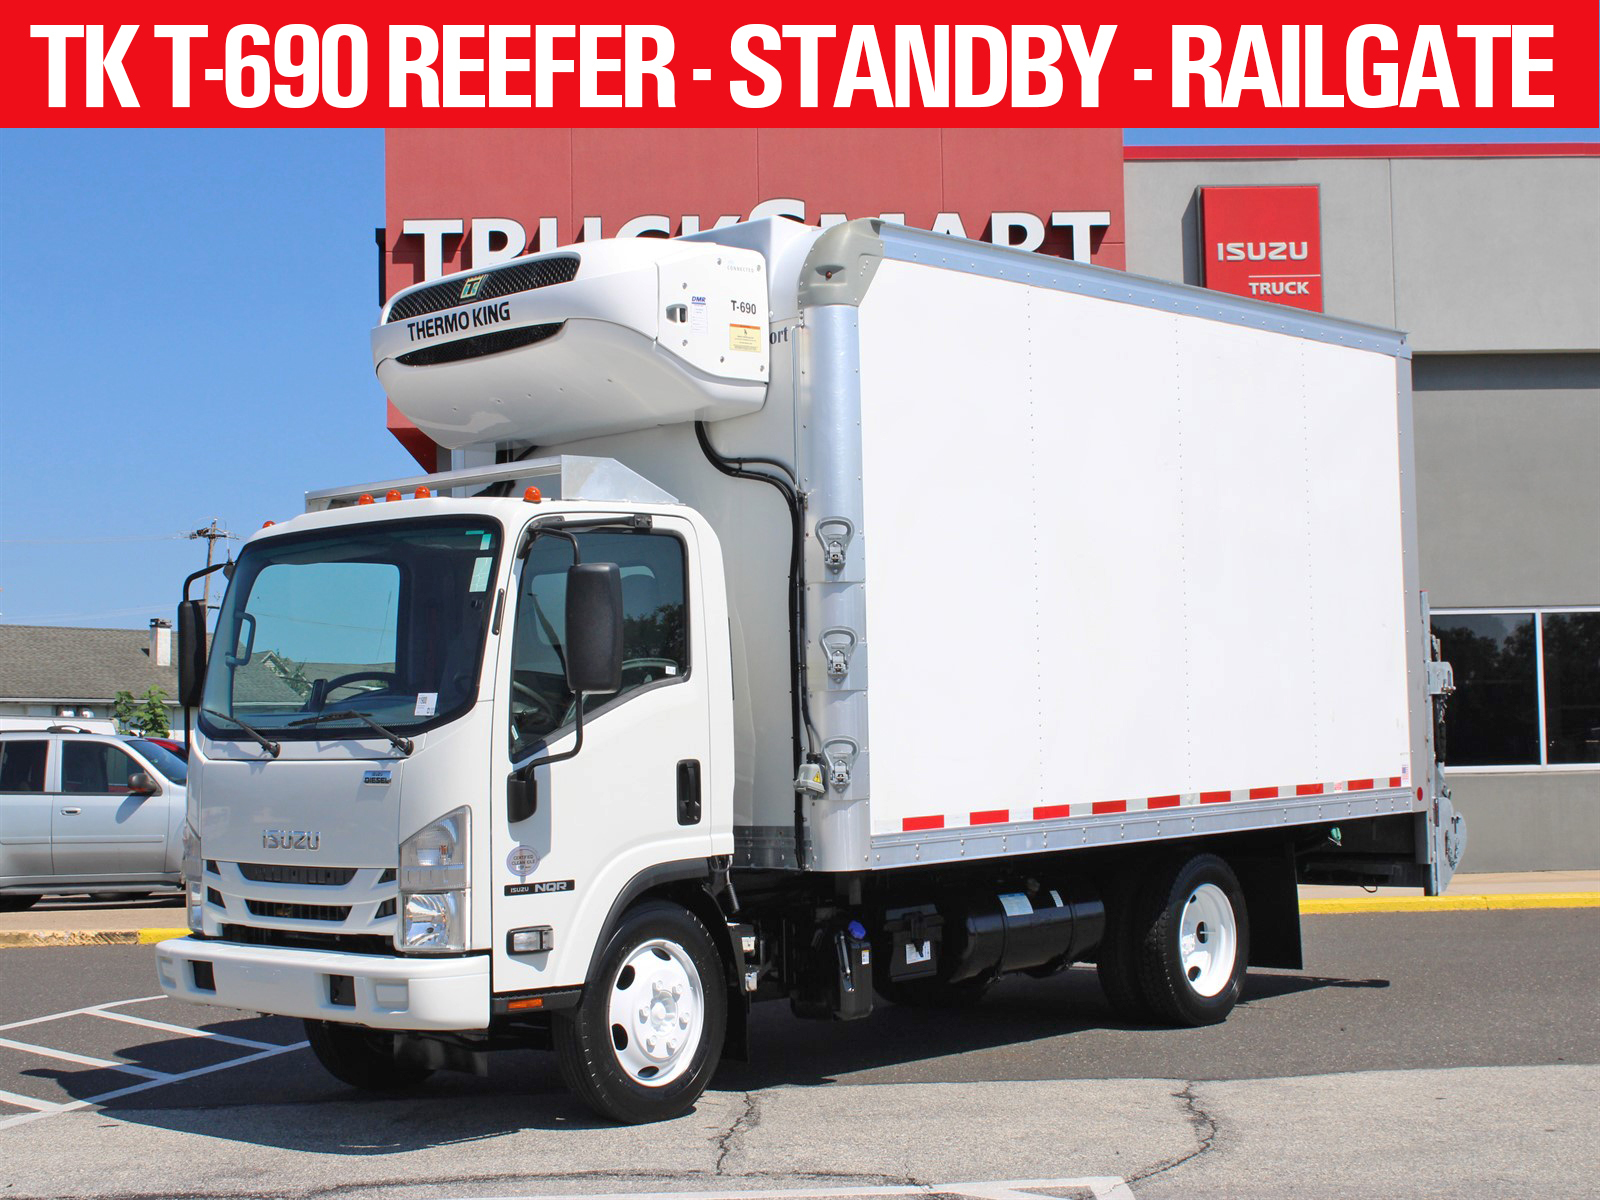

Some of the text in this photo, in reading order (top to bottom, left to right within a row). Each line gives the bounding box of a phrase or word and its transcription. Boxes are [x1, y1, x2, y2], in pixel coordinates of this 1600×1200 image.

[1217, 241, 1308, 261] ISUZU
[1248, 282, 1309, 295] TRUCK
[730, 300, 757, 314] T-690
[407, 301, 511, 342] THERMO KING
[263, 829, 321, 851] ISUZU
[534, 881, 567, 893] NQR
